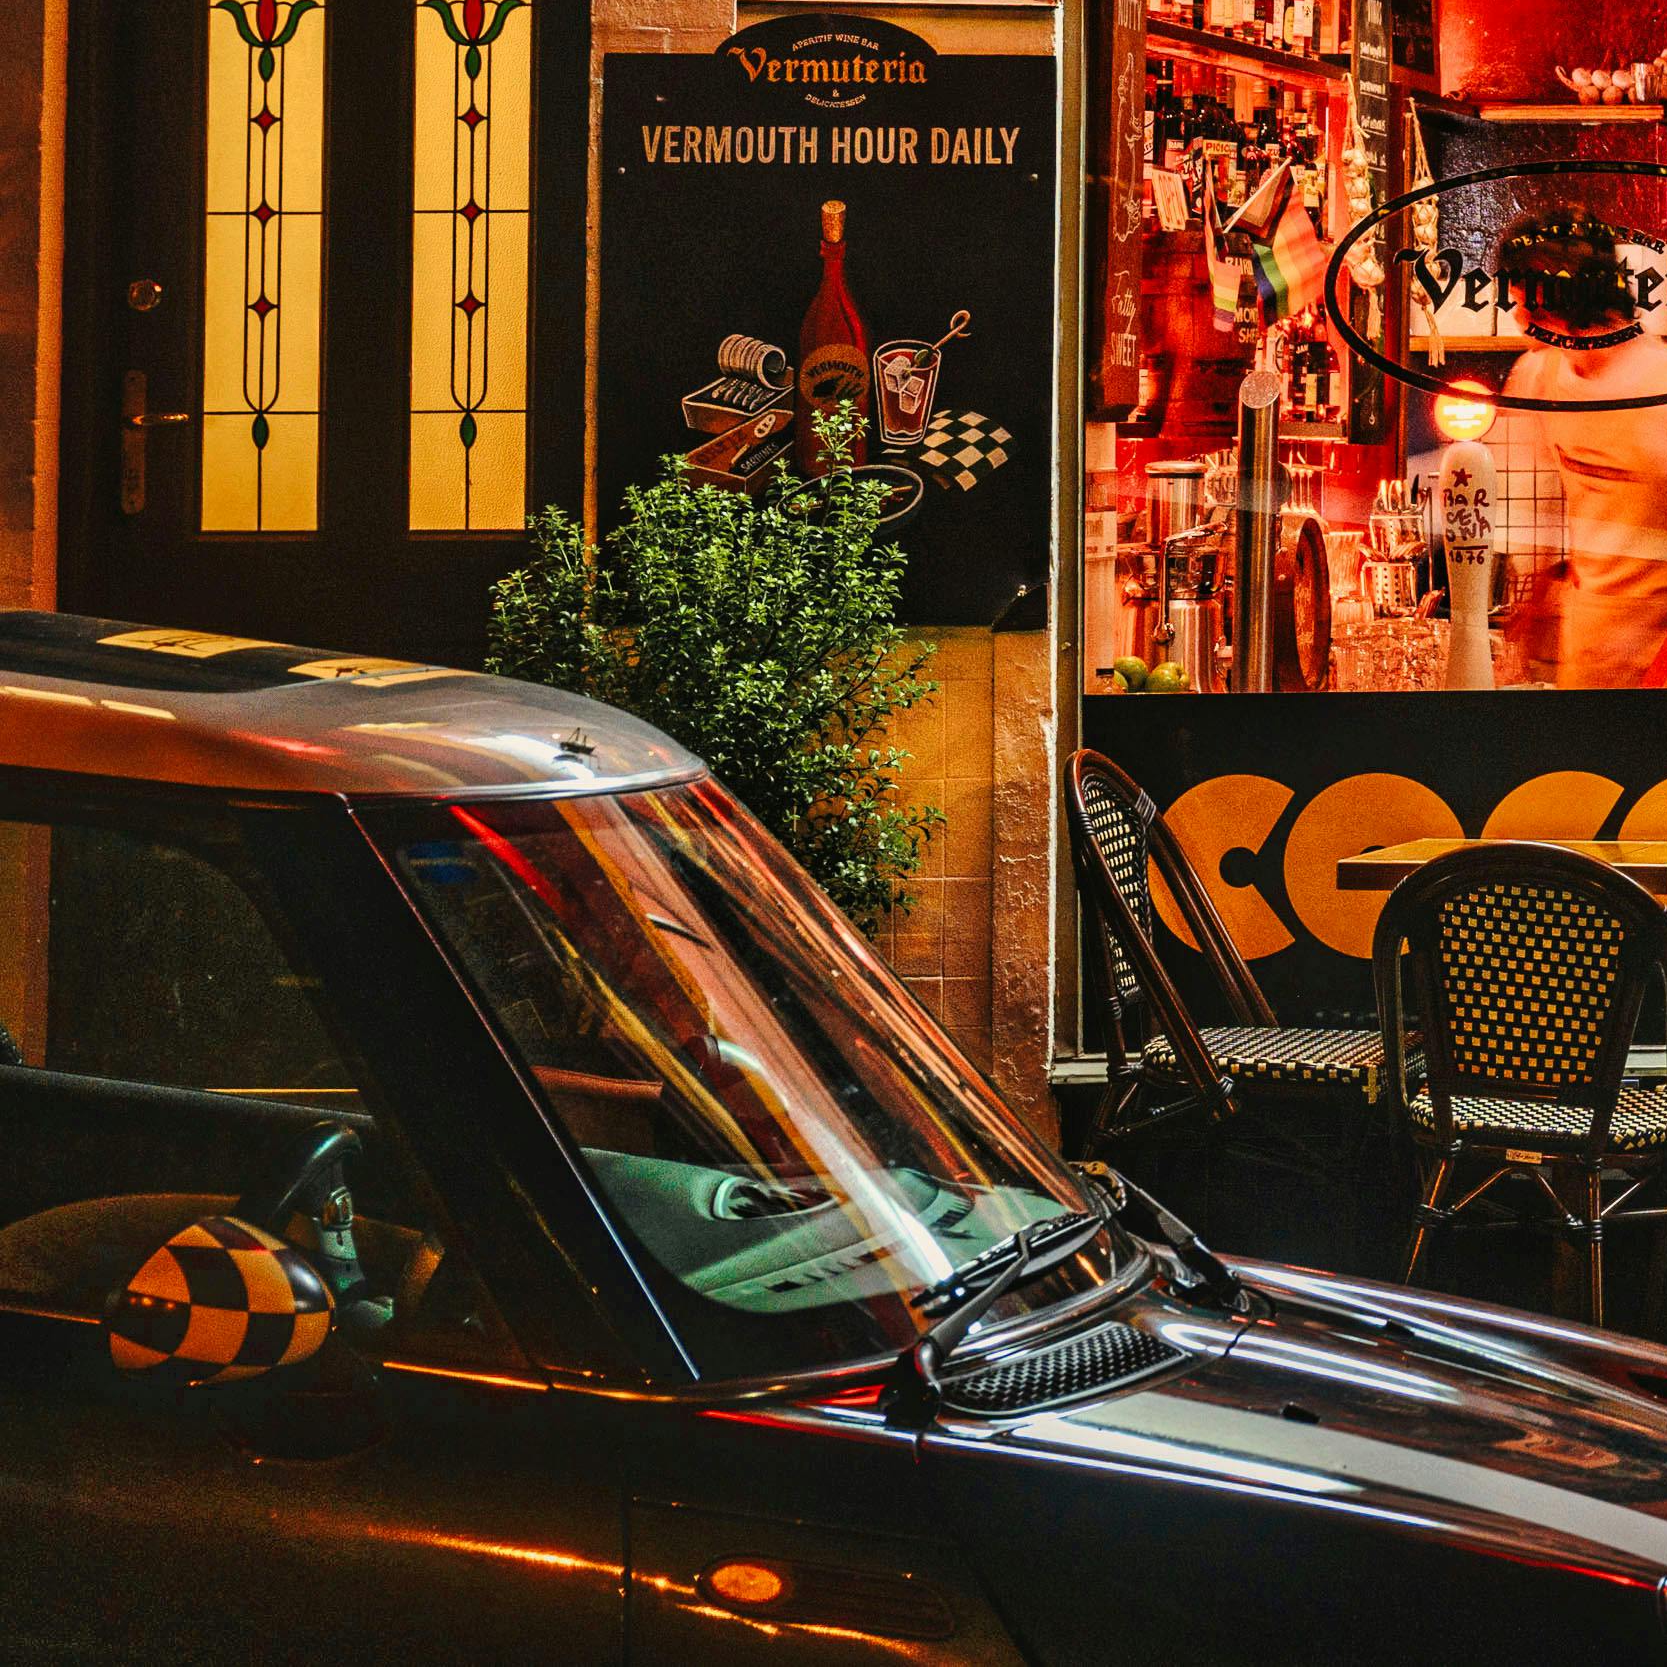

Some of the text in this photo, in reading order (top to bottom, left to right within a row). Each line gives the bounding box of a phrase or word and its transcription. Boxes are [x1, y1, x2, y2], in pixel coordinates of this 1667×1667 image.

[792, 34, 880, 51] APERITIF WINE BAR
[727, 46, 929, 84] Vermuteria
[804, 93, 867, 109] DELICATESSEN
[642, 125, 1021, 165] VERMOUTH HOUR DAILY
[806, 359, 865, 379] VERMOUTH
[740, 441, 781, 473] SARDINES
